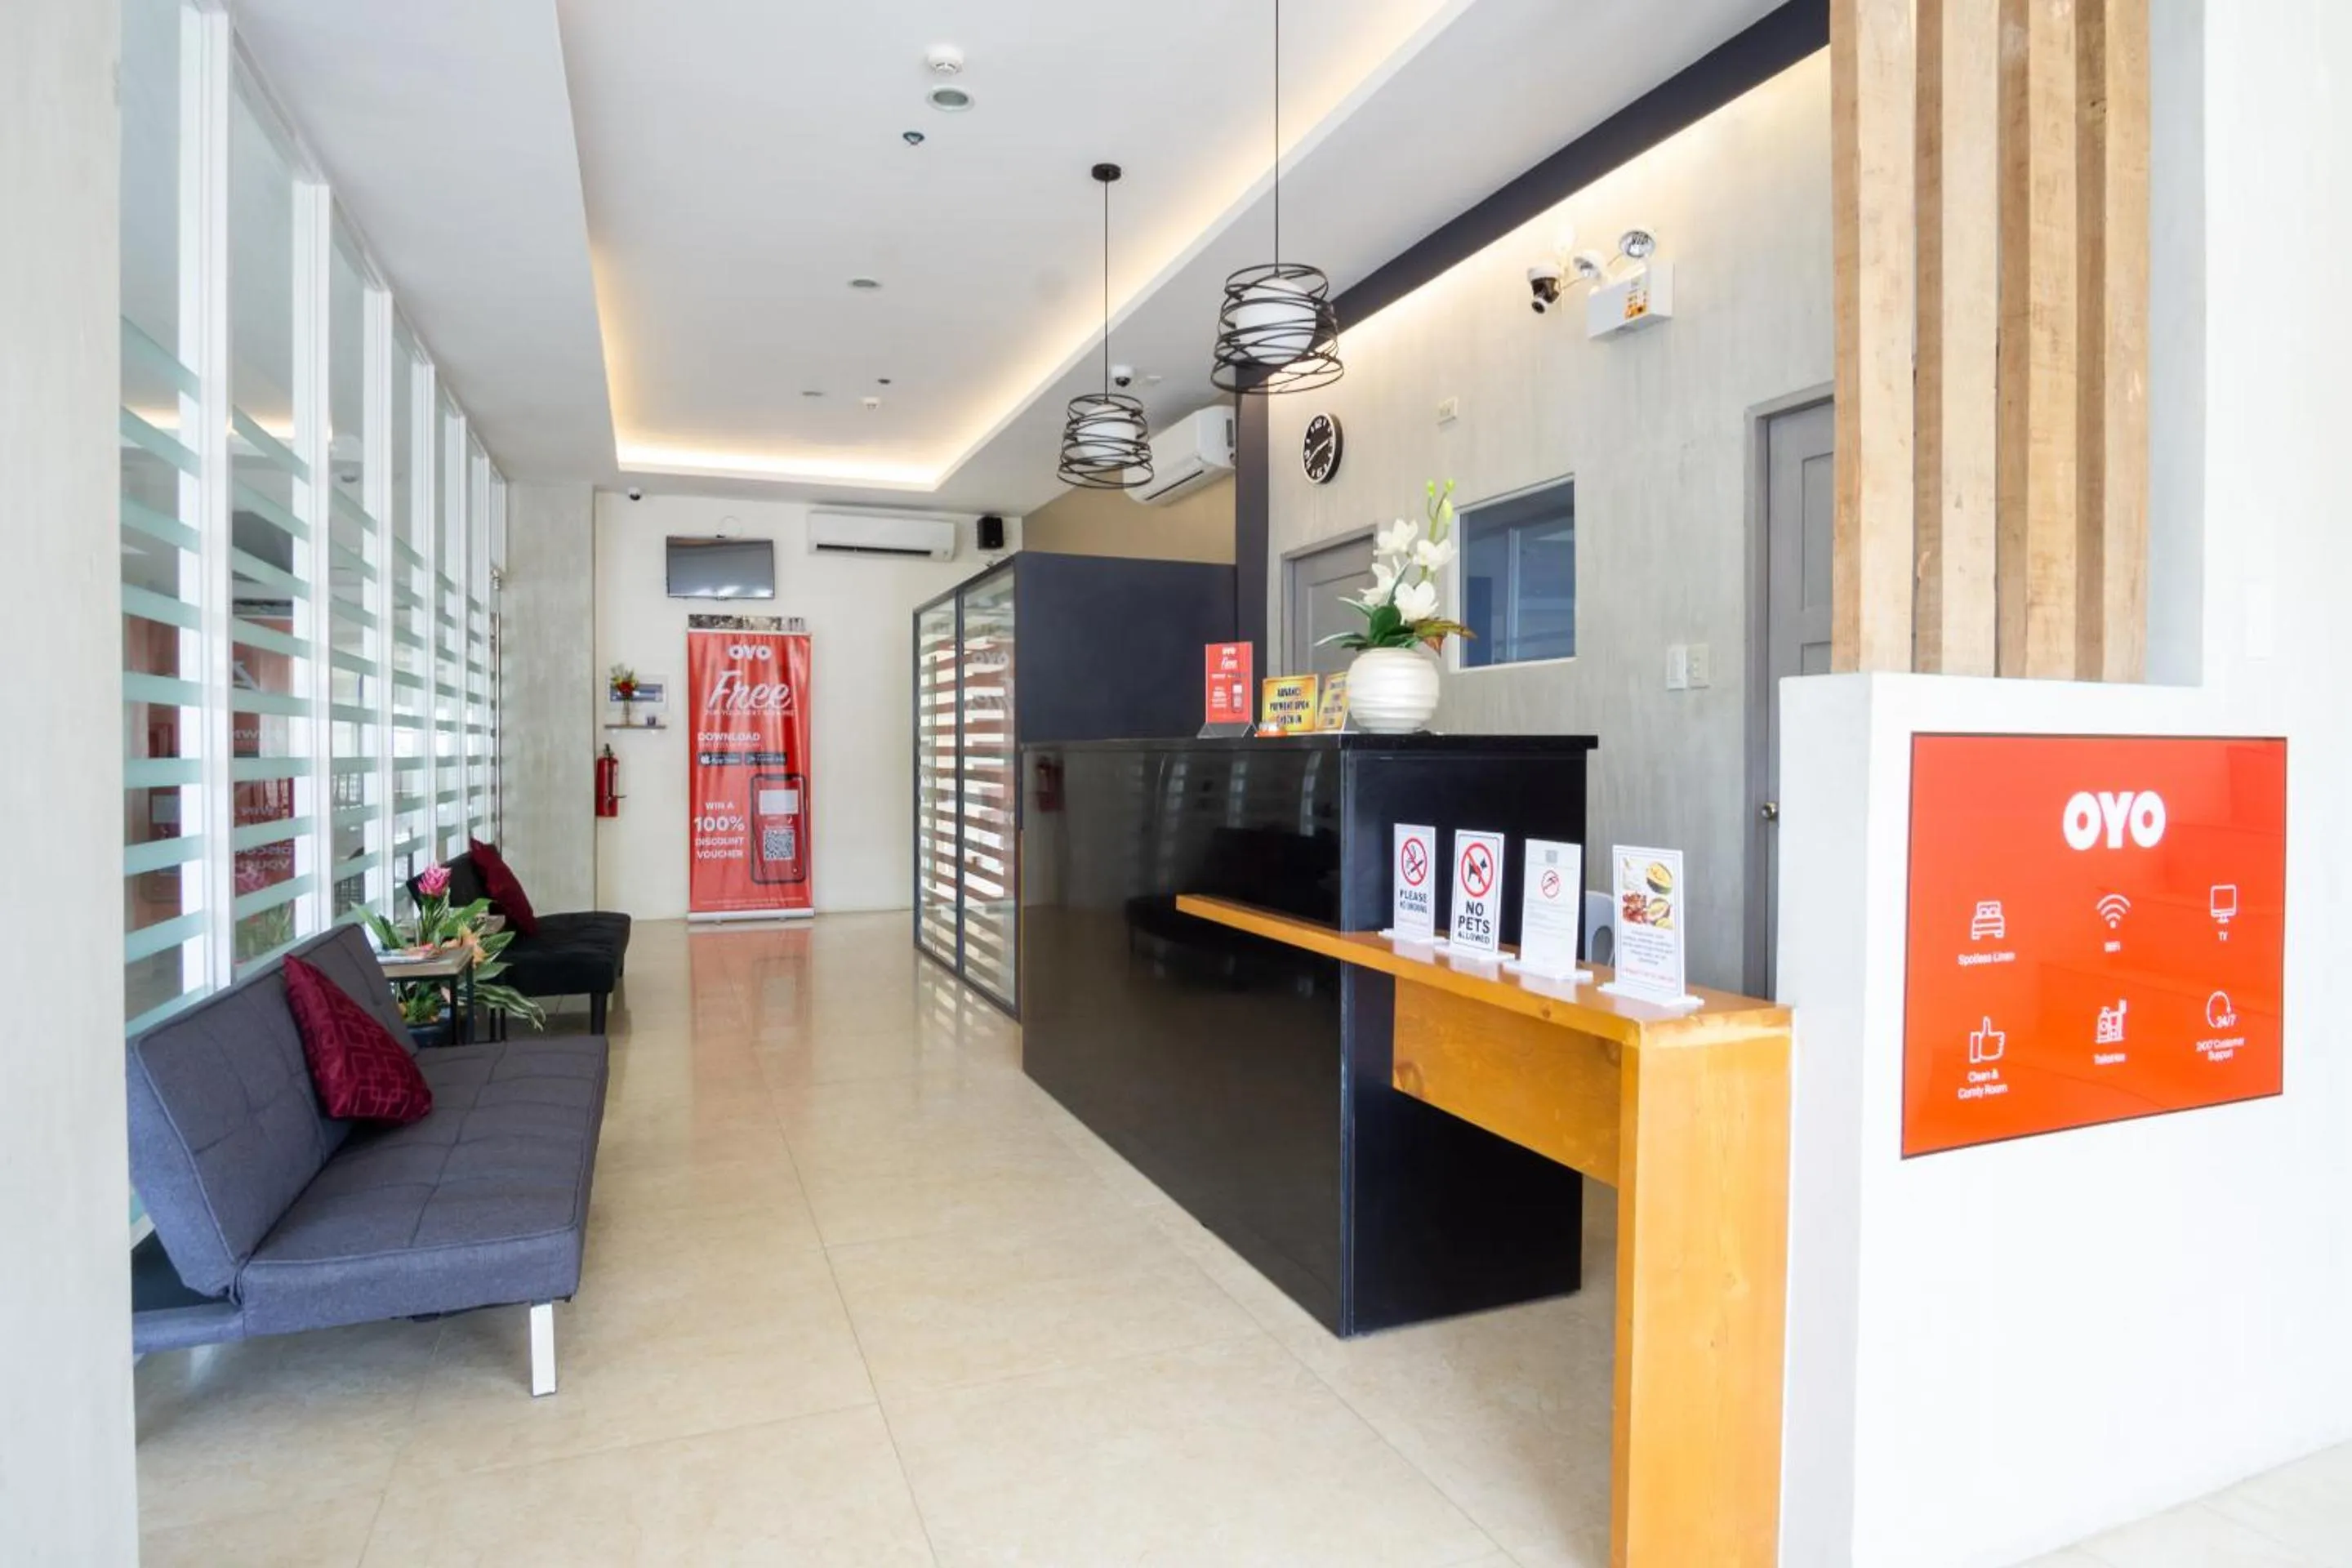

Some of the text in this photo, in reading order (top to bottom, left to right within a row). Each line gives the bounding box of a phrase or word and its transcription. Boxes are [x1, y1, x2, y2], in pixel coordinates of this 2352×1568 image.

[728, 644, 772, 661] OYO
[708, 670, 791, 710] Free
[697, 732, 761, 742] DOWNLOAD
[705, 801, 735, 811] WIN A
[694, 816, 746, 832] 100%
[2063, 790, 2167, 851] OYO
[695, 836, 745, 847] DISCOUNT
[697, 850, 744, 859] VOUCHER
[1400, 889, 1428, 903] PLEASE
[1466, 900, 1484, 916] NO
[1458, 915, 1490, 933] PETS
[1458, 930, 1490, 945] ALLOWED
